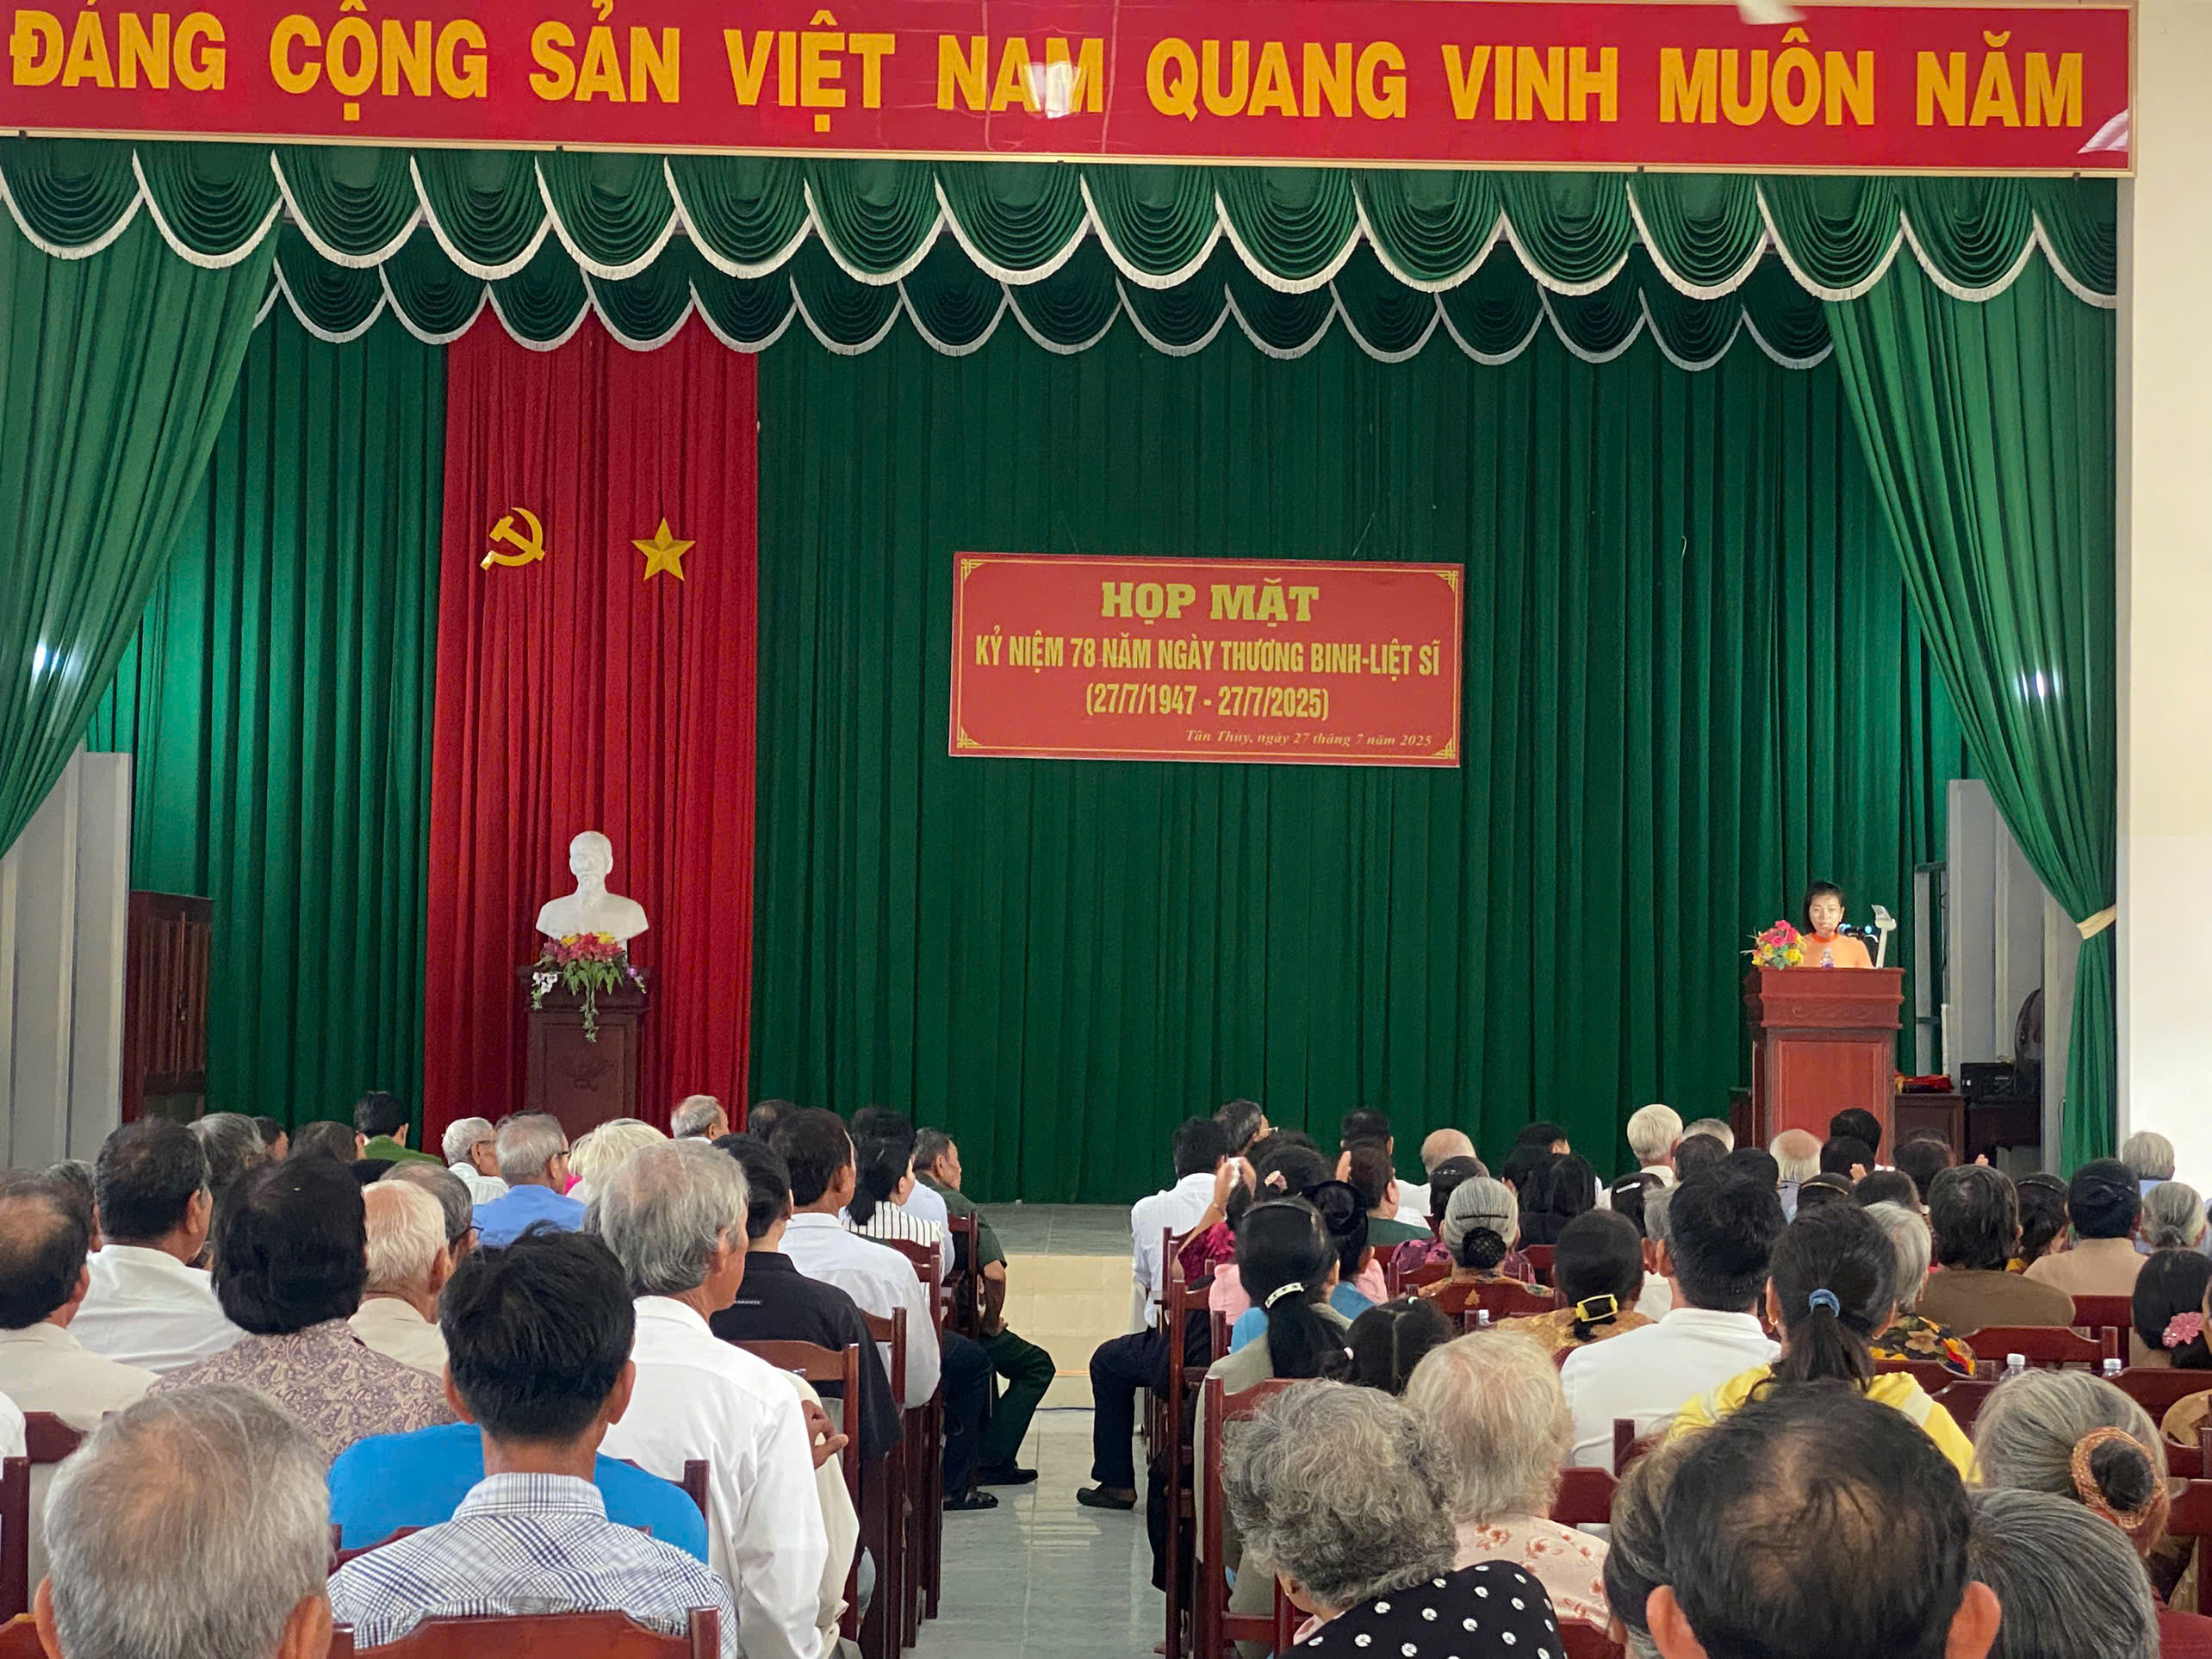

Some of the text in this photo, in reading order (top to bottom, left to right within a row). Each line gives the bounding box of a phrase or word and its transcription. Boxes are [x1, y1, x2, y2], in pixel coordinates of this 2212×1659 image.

[270, 0, 488, 121] CỘNG
[530, 0, 680, 103] SẢN
[724, 10, 895, 132] VIỆT
[937, 35, 1103, 113] NAM
[1146, 38, 1407, 121] QUANG
[1442, 45, 1619, 121] VINH
[1661, 28, 1874, 125] MUÔN
[1917, 31, 2083, 127] NĂM
[1102, 578, 1320, 628] HỌP MẶT
[975, 624, 1441, 681] KỶ NIỆM 78 NĂM NGÀY THƯƠNG BINH-LIỆT SĨ
[1085, 683, 1197, 716] (27/7/1947
[1218, 686, 1330, 721] 27/7/2025)
[1187, 730, 1211, 742] Tân
[1258, 732, 1289, 746] ngày
[1293, 732, 1309, 744] 27
[1313, 733, 1351, 747] tháng
[1356, 733, 1364, 745] 7
[1367, 734, 1395, 745] năm
[1400, 734, 1432, 746] 2025
